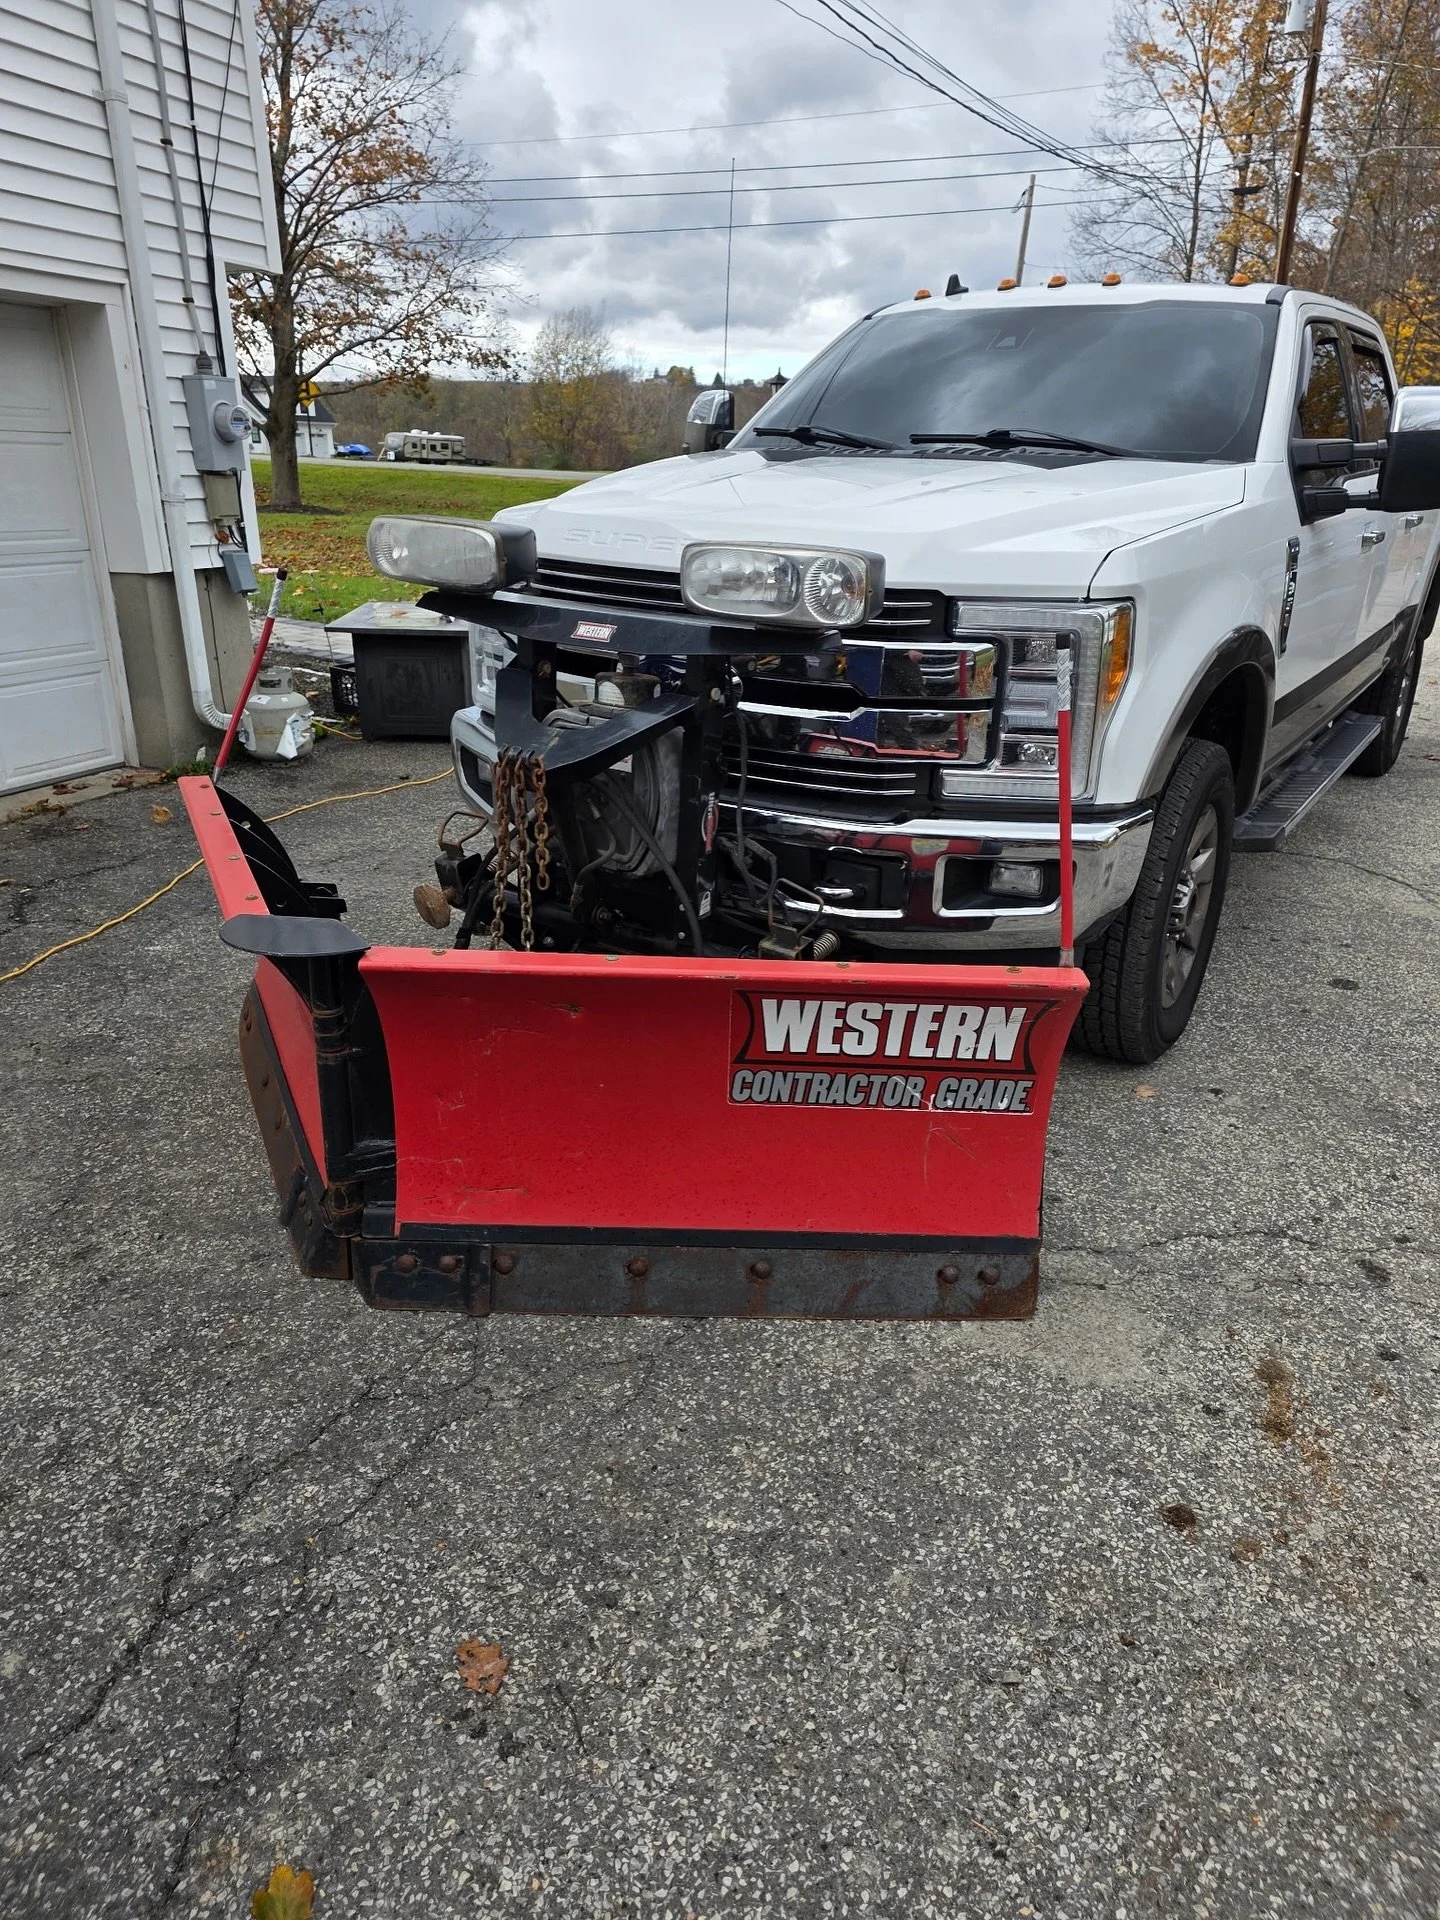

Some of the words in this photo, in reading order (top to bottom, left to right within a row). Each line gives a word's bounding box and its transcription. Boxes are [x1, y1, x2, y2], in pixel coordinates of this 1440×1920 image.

[761, 998, 1027, 1061] WESTERN
[731, 1069, 927, 1107] CONTRACTOR
[934, 1076, 1035, 1112] GRADE
